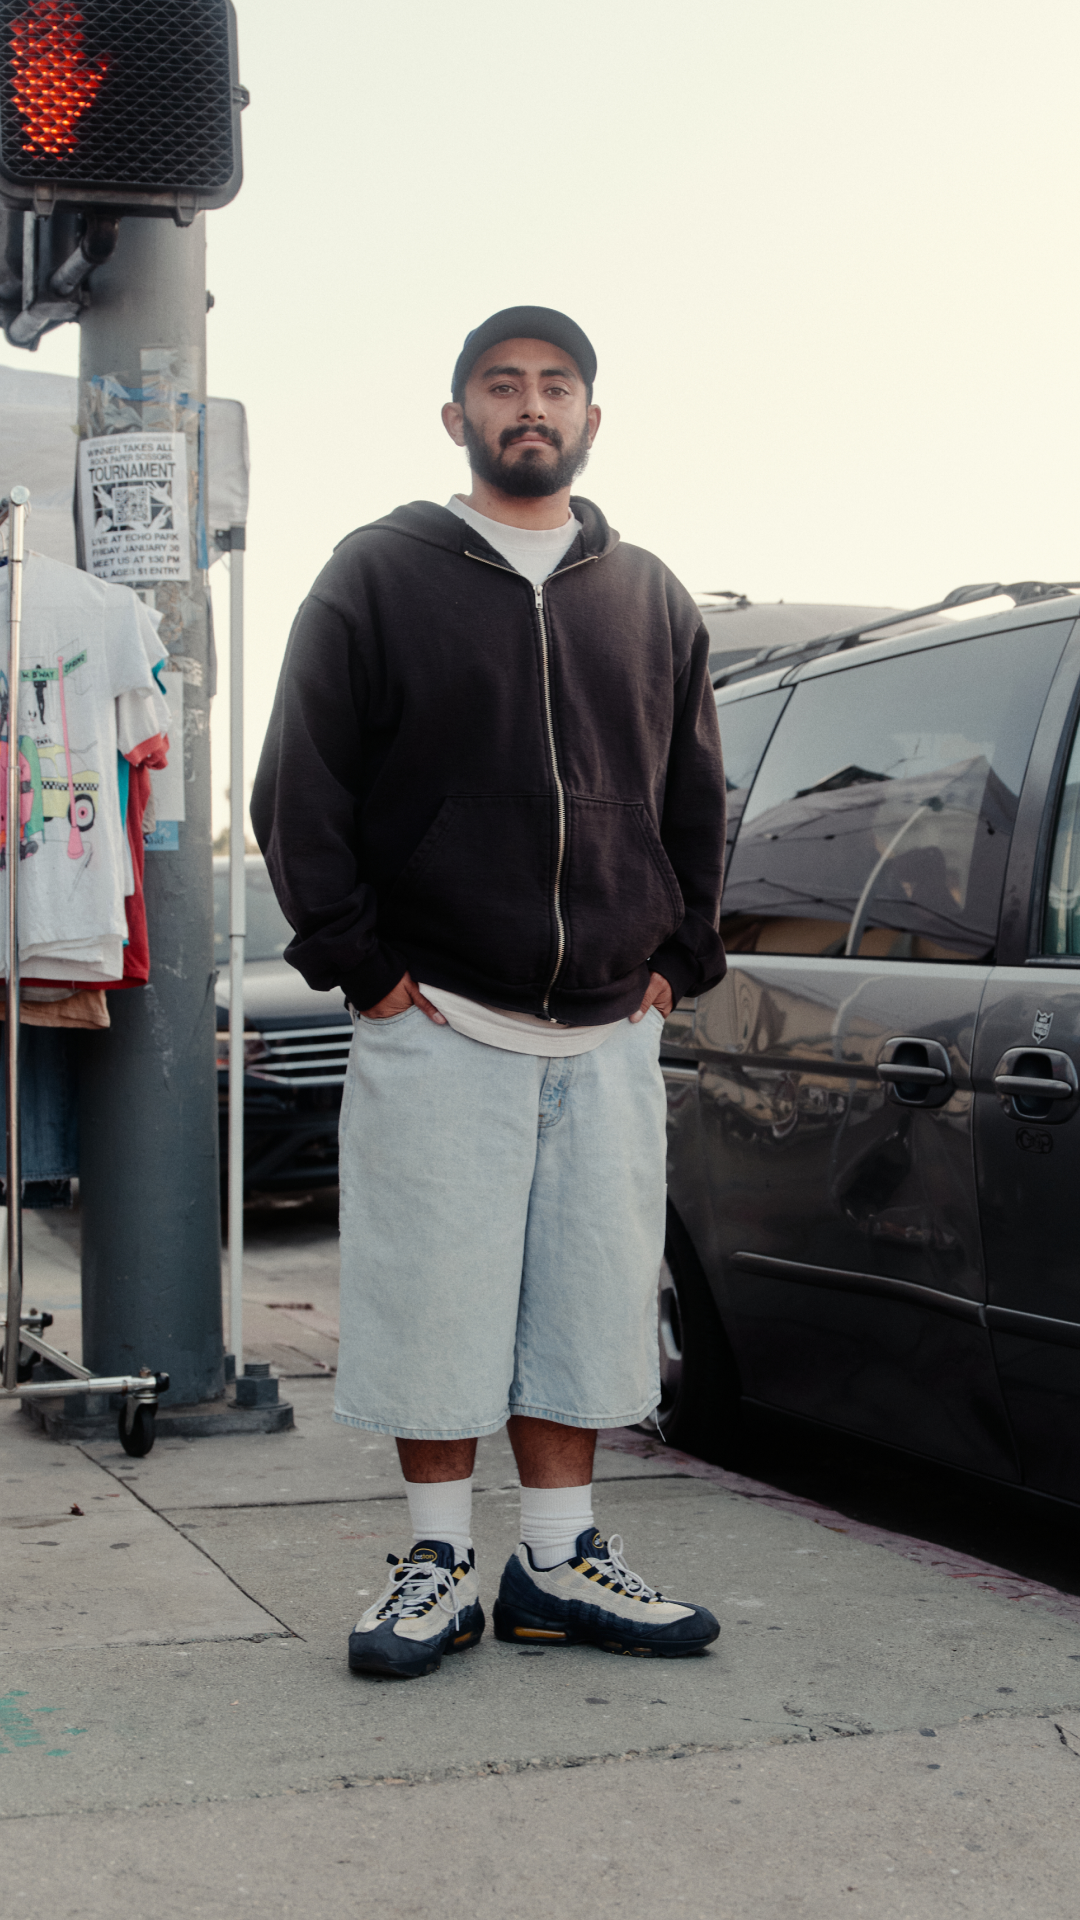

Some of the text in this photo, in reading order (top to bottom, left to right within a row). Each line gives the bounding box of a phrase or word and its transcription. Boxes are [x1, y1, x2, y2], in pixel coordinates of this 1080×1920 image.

[87, 442, 174, 457] WINNER TAKES ALL
[90, 453, 172, 466] ROCK PAPER SCISSORS
[88, 462, 176, 483] TOURNAMENT
[92, 537, 108, 546] LIVE
[125, 534, 152, 542] ECHO
[154, 533, 178, 541] PARK
[92, 547, 120, 556] FRIDAY
[123, 544, 166, 553] JANUARY
[92, 558, 115, 568] MEET
[118, 556, 130, 564] US
[111, 568, 135, 577] AGES
[150, 567, 180, 575] ENTRY
